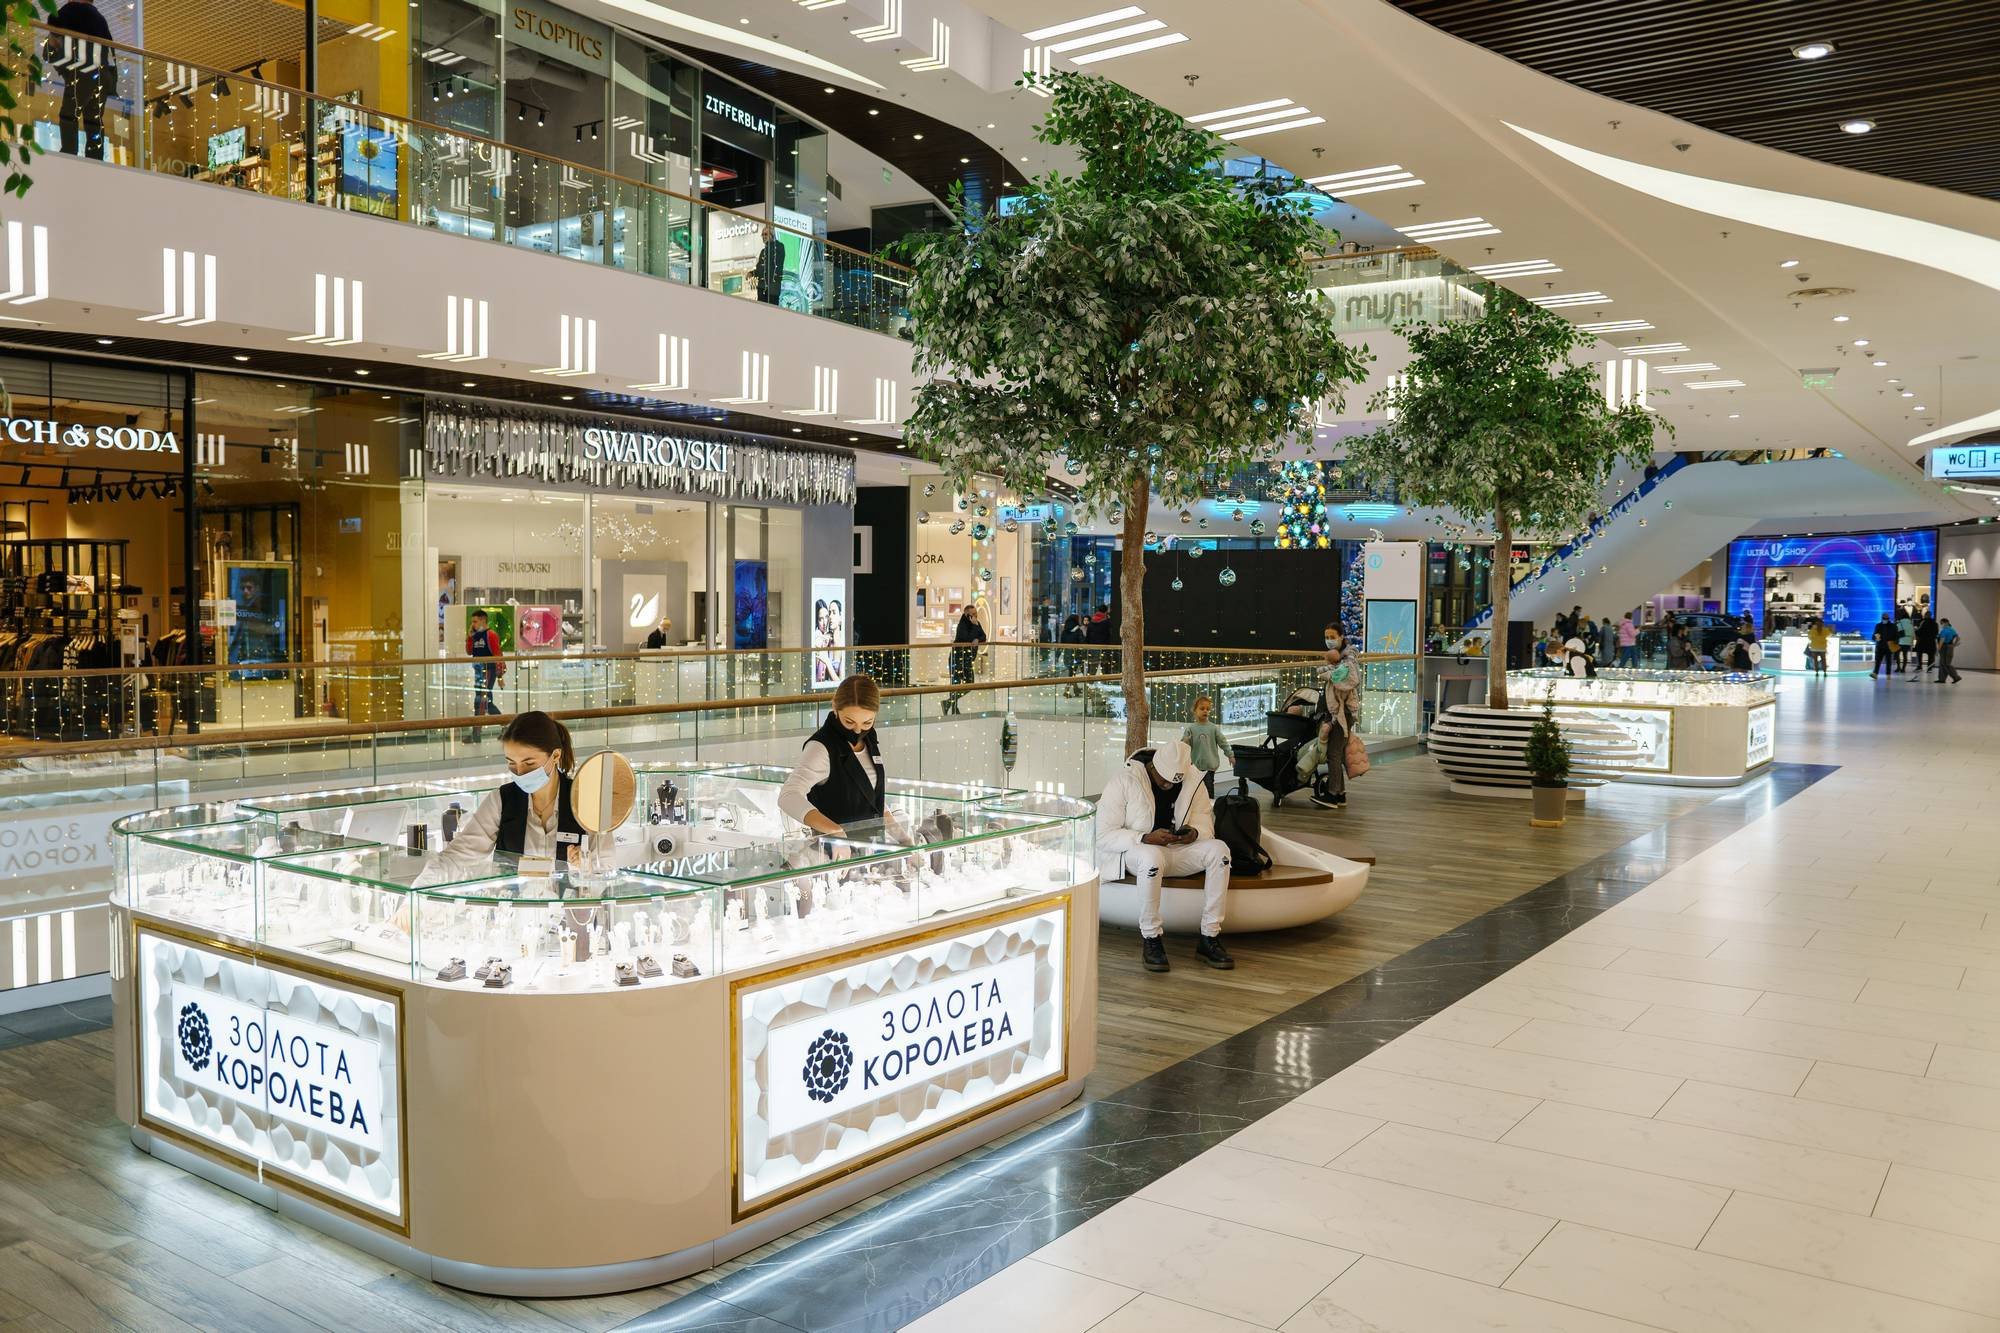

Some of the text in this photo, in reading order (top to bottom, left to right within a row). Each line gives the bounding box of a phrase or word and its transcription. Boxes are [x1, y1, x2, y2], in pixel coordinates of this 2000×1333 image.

[514, 7, 603, 60] ST.OPTICS
[705, 94, 776, 138] ZIFFERBLATT
[62, 423, 91, 448] &
[95, 426, 180, 454] SODA
[584, 428, 728, 473] SWAROVSKI
[1949, 453, 1966, 465] WC
[1785, 547, 1807, 556] SHOP
[1865, 544, 1885, 553] ULTRA
[1897, 542, 1916, 552] SHOP
[1947, 558, 1968, 576] ZARA
[881, 977, 1001, 1041] ЗОЛОТА
[229, 1015, 352, 1085] ЗОЛОТА
[863, 1011, 1013, 1091] КОРОЛЕВА
[216, 1051, 369, 1135] КОРОЛЕВА
